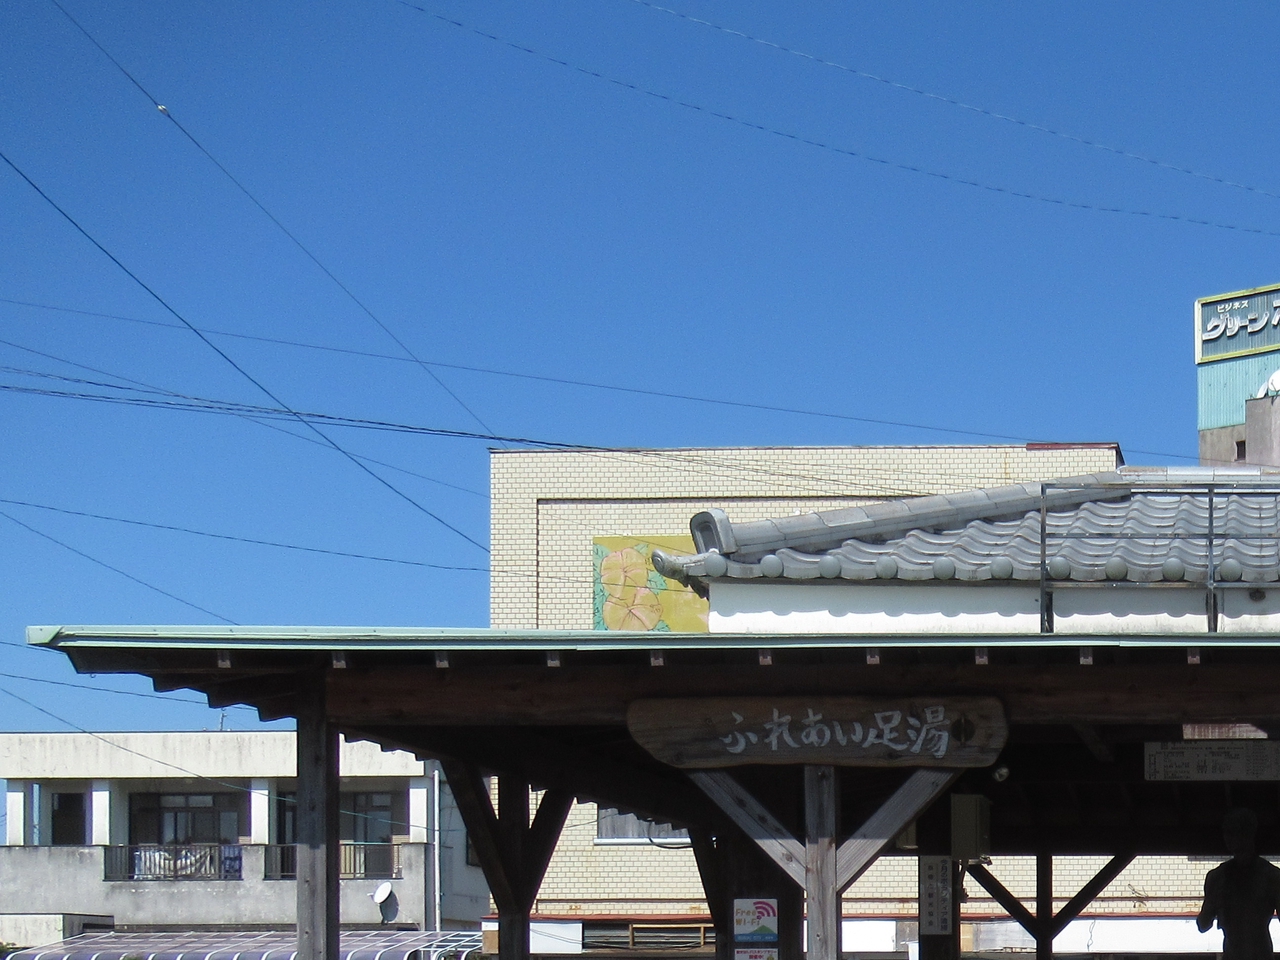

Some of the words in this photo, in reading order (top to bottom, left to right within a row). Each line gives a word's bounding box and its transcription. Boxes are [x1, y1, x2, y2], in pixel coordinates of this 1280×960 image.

[1217, 300, 1249, 313] ビジネス
[718, 704, 951, 758] ふれあい足湯
